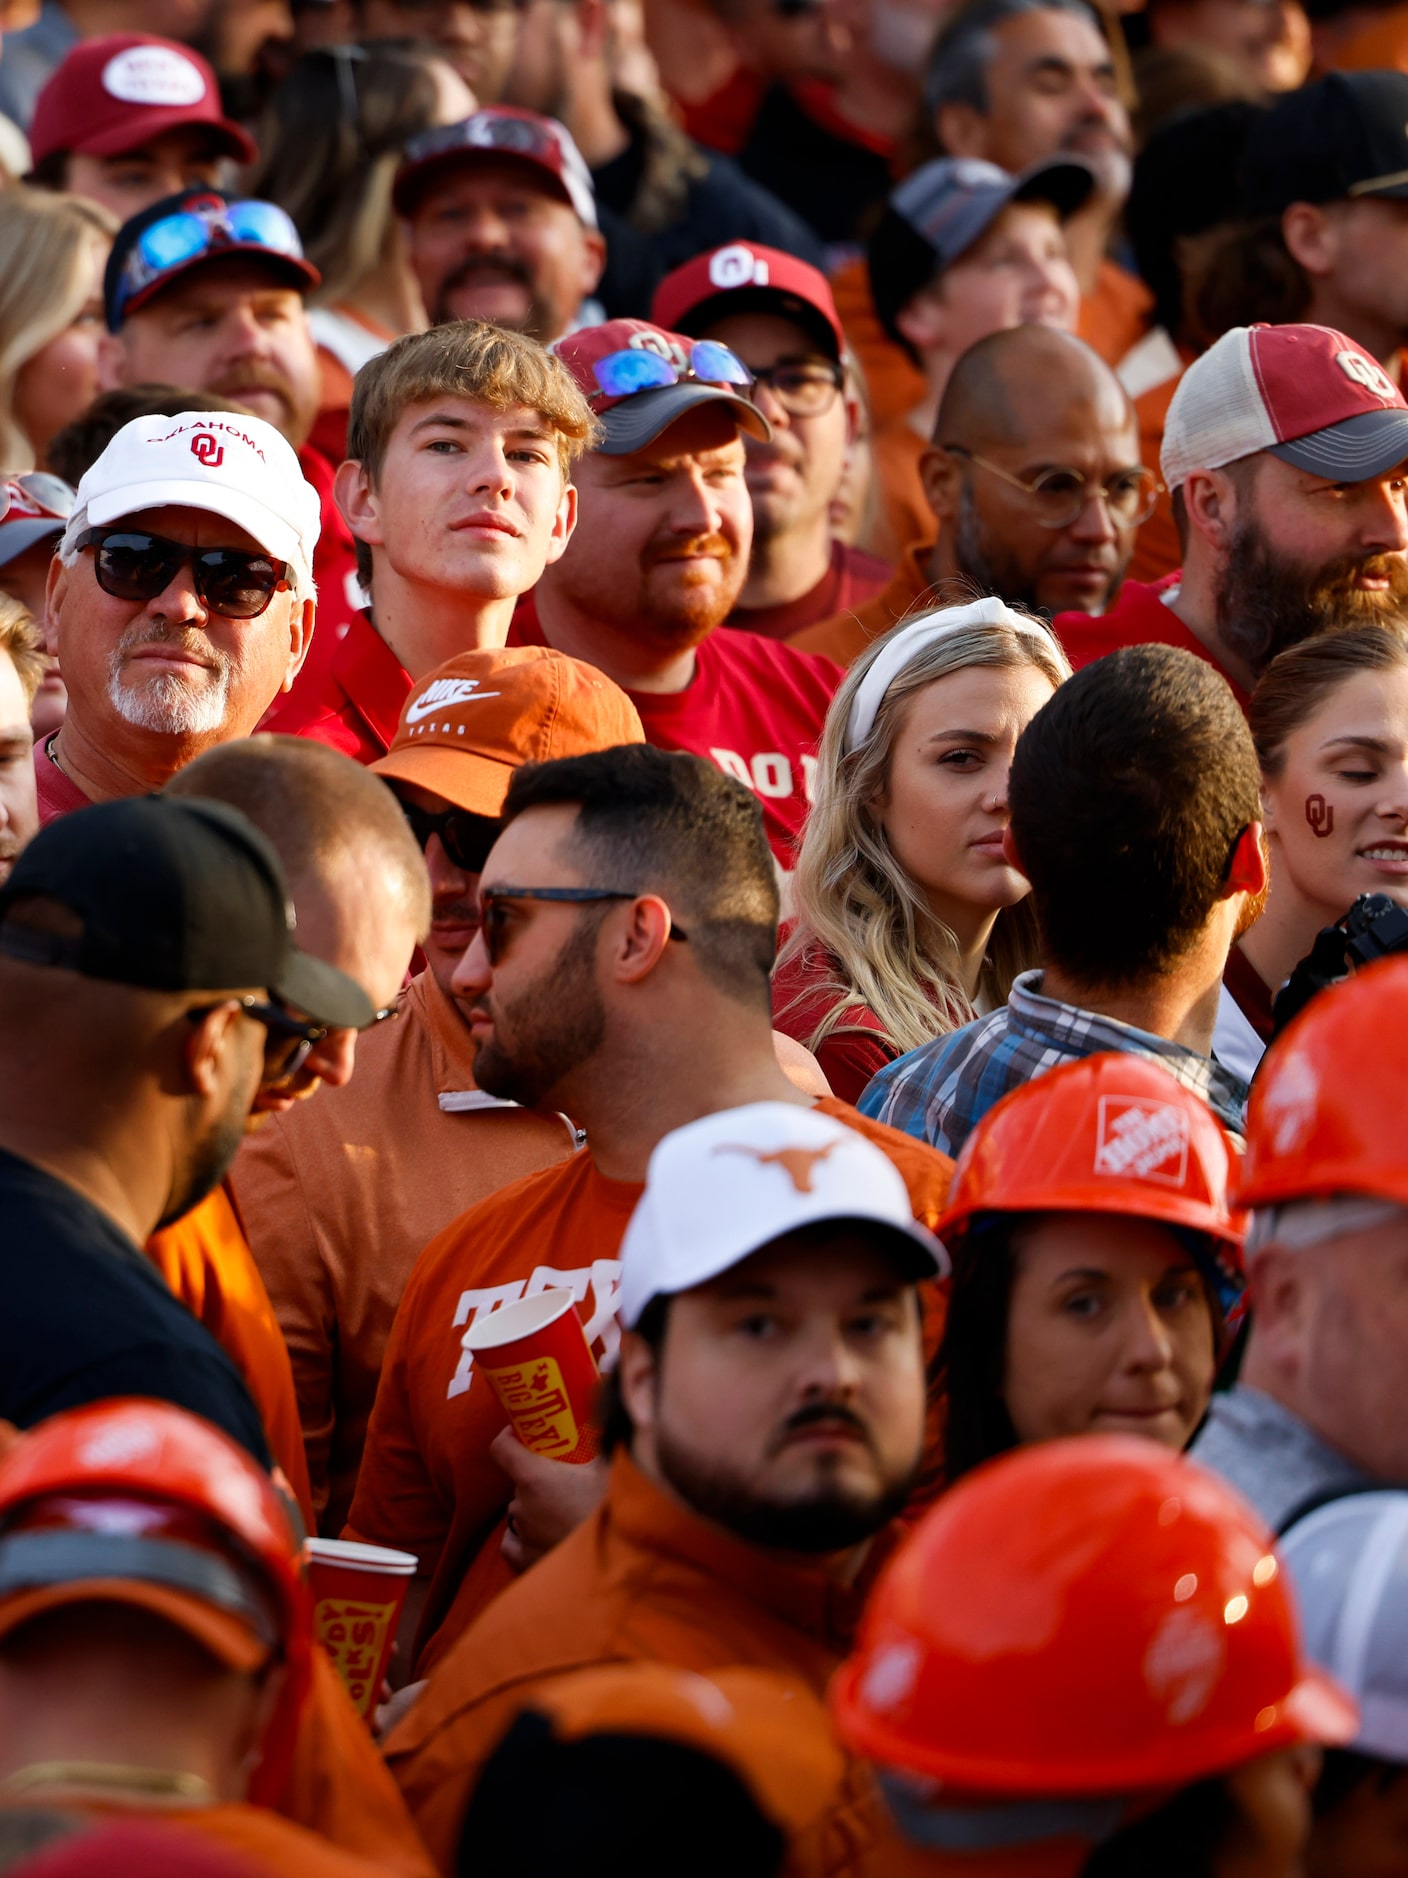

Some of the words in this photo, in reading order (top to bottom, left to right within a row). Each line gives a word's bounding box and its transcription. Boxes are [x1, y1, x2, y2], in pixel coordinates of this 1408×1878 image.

[1336, 350, 1396, 398] OU
[147, 421, 266, 464] OKLAHOMA
[190, 433, 224, 467] OU
[418, 678, 480, 705] NIKE
[409, 722, 466, 737] TEXAS
[1305, 794, 1334, 838] OU
[497, 1371, 532, 1403] BIG
